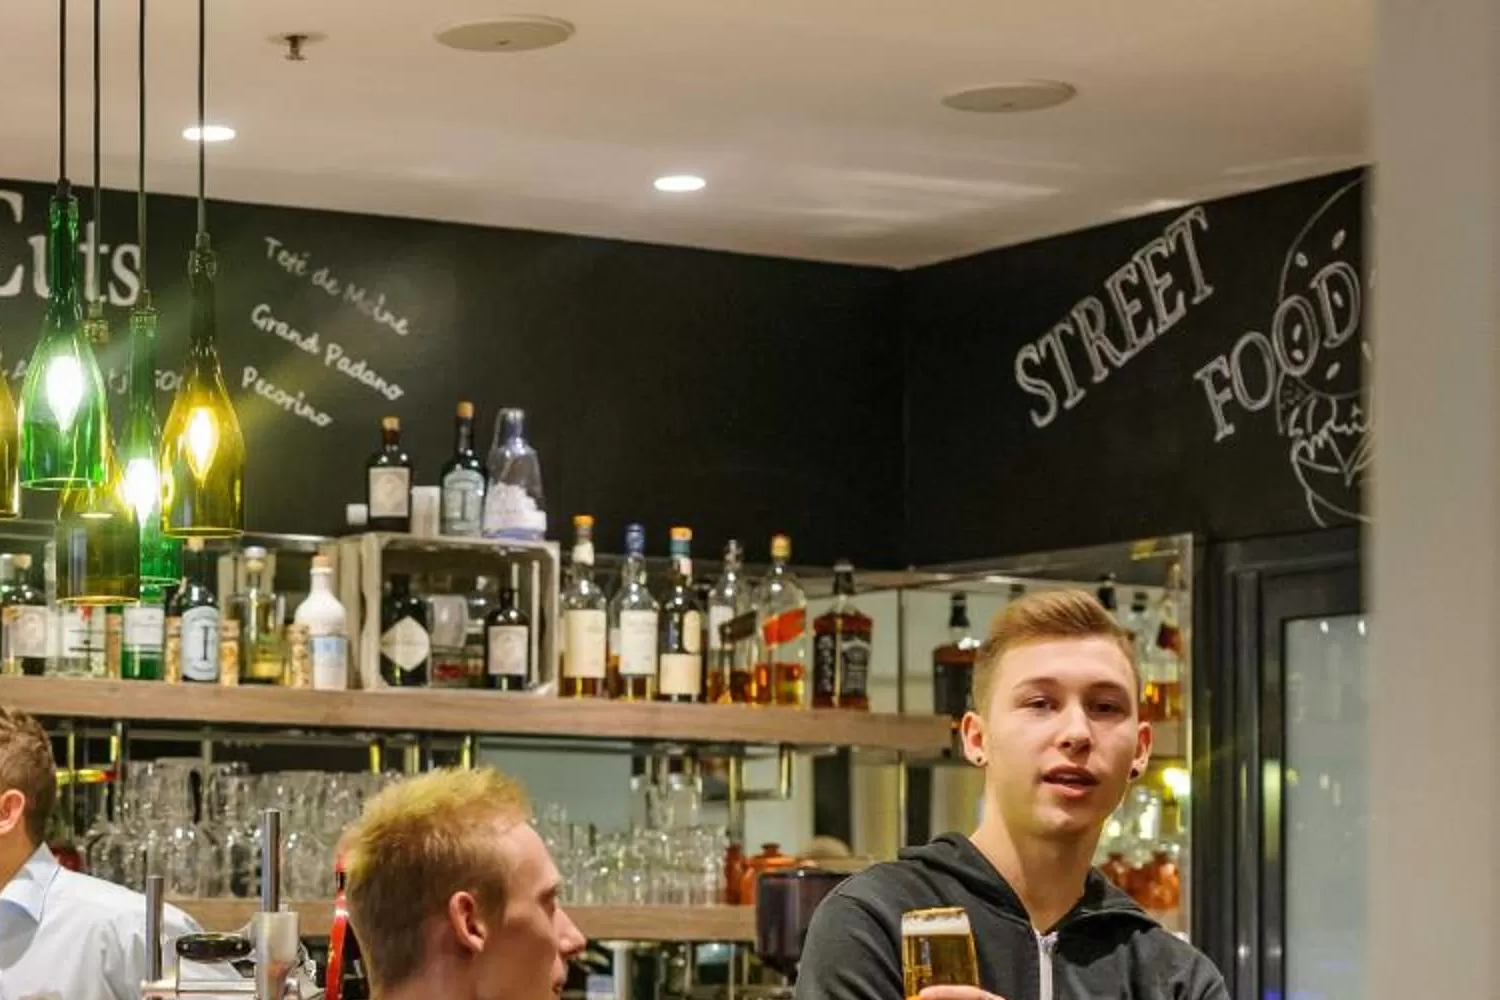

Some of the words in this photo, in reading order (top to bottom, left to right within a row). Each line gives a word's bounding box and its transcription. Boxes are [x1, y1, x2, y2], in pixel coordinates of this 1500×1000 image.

[311, 267, 342, 297] de
[1013, 204, 1215, 429] STREET
[240, 365, 335, 427] Pecorino
[250, 303, 321, 356] Grand
[323, 342, 406, 401] Padano
[1192, 260, 1362, 443] FOOD
